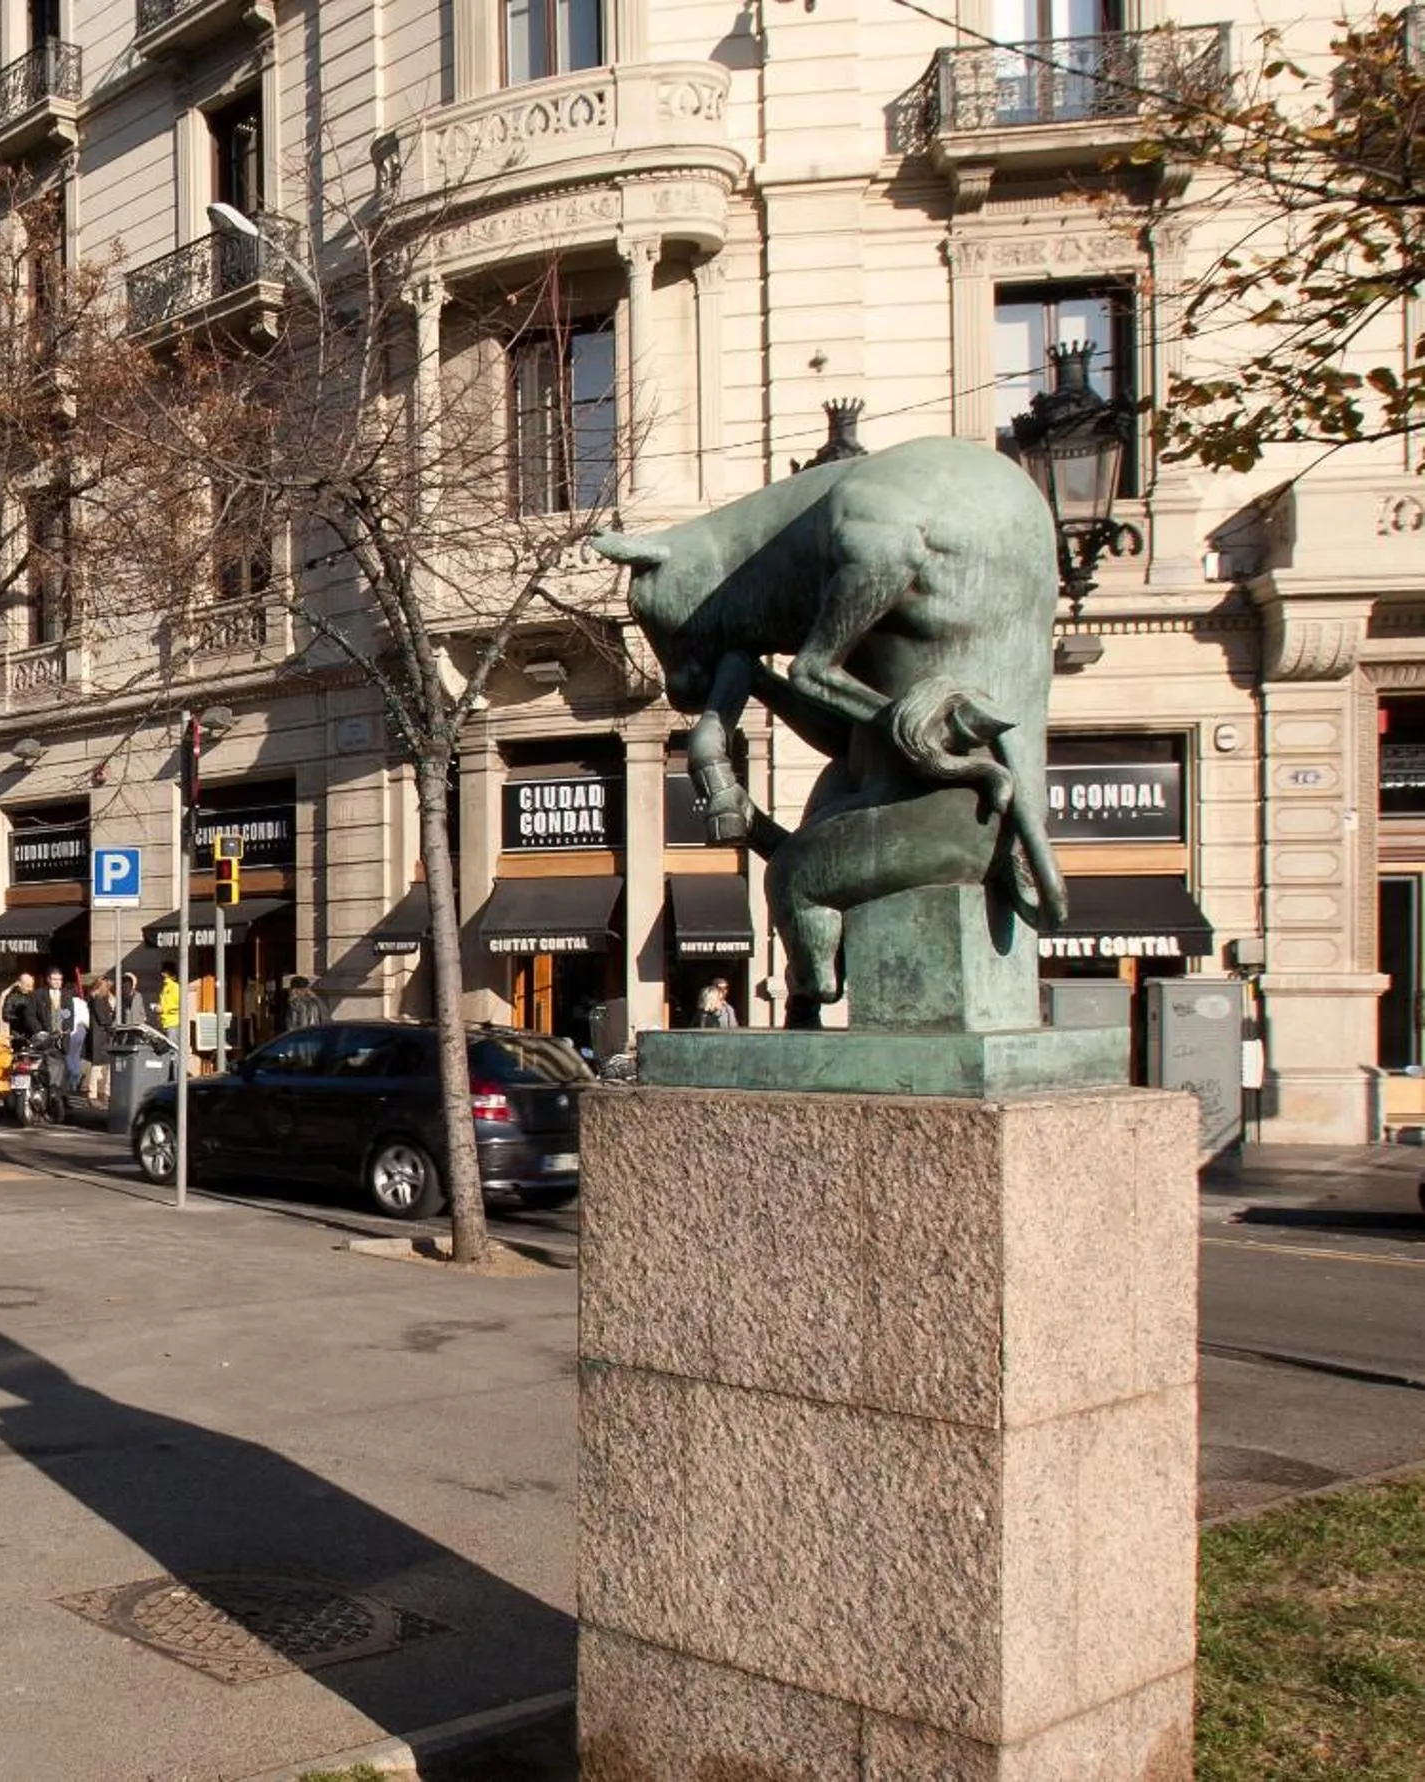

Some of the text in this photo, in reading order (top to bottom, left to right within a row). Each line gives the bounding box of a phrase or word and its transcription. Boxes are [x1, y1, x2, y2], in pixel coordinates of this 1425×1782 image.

[520, 784, 605, 810] CIUDAD
[1071, 783, 1166, 810] CONDAL
[520, 809, 605, 836] CONDAL
[102, 854, 130, 892] P
[489, 938, 536, 952] CIUTAT
[1038, 937, 1095, 958] UTAT
